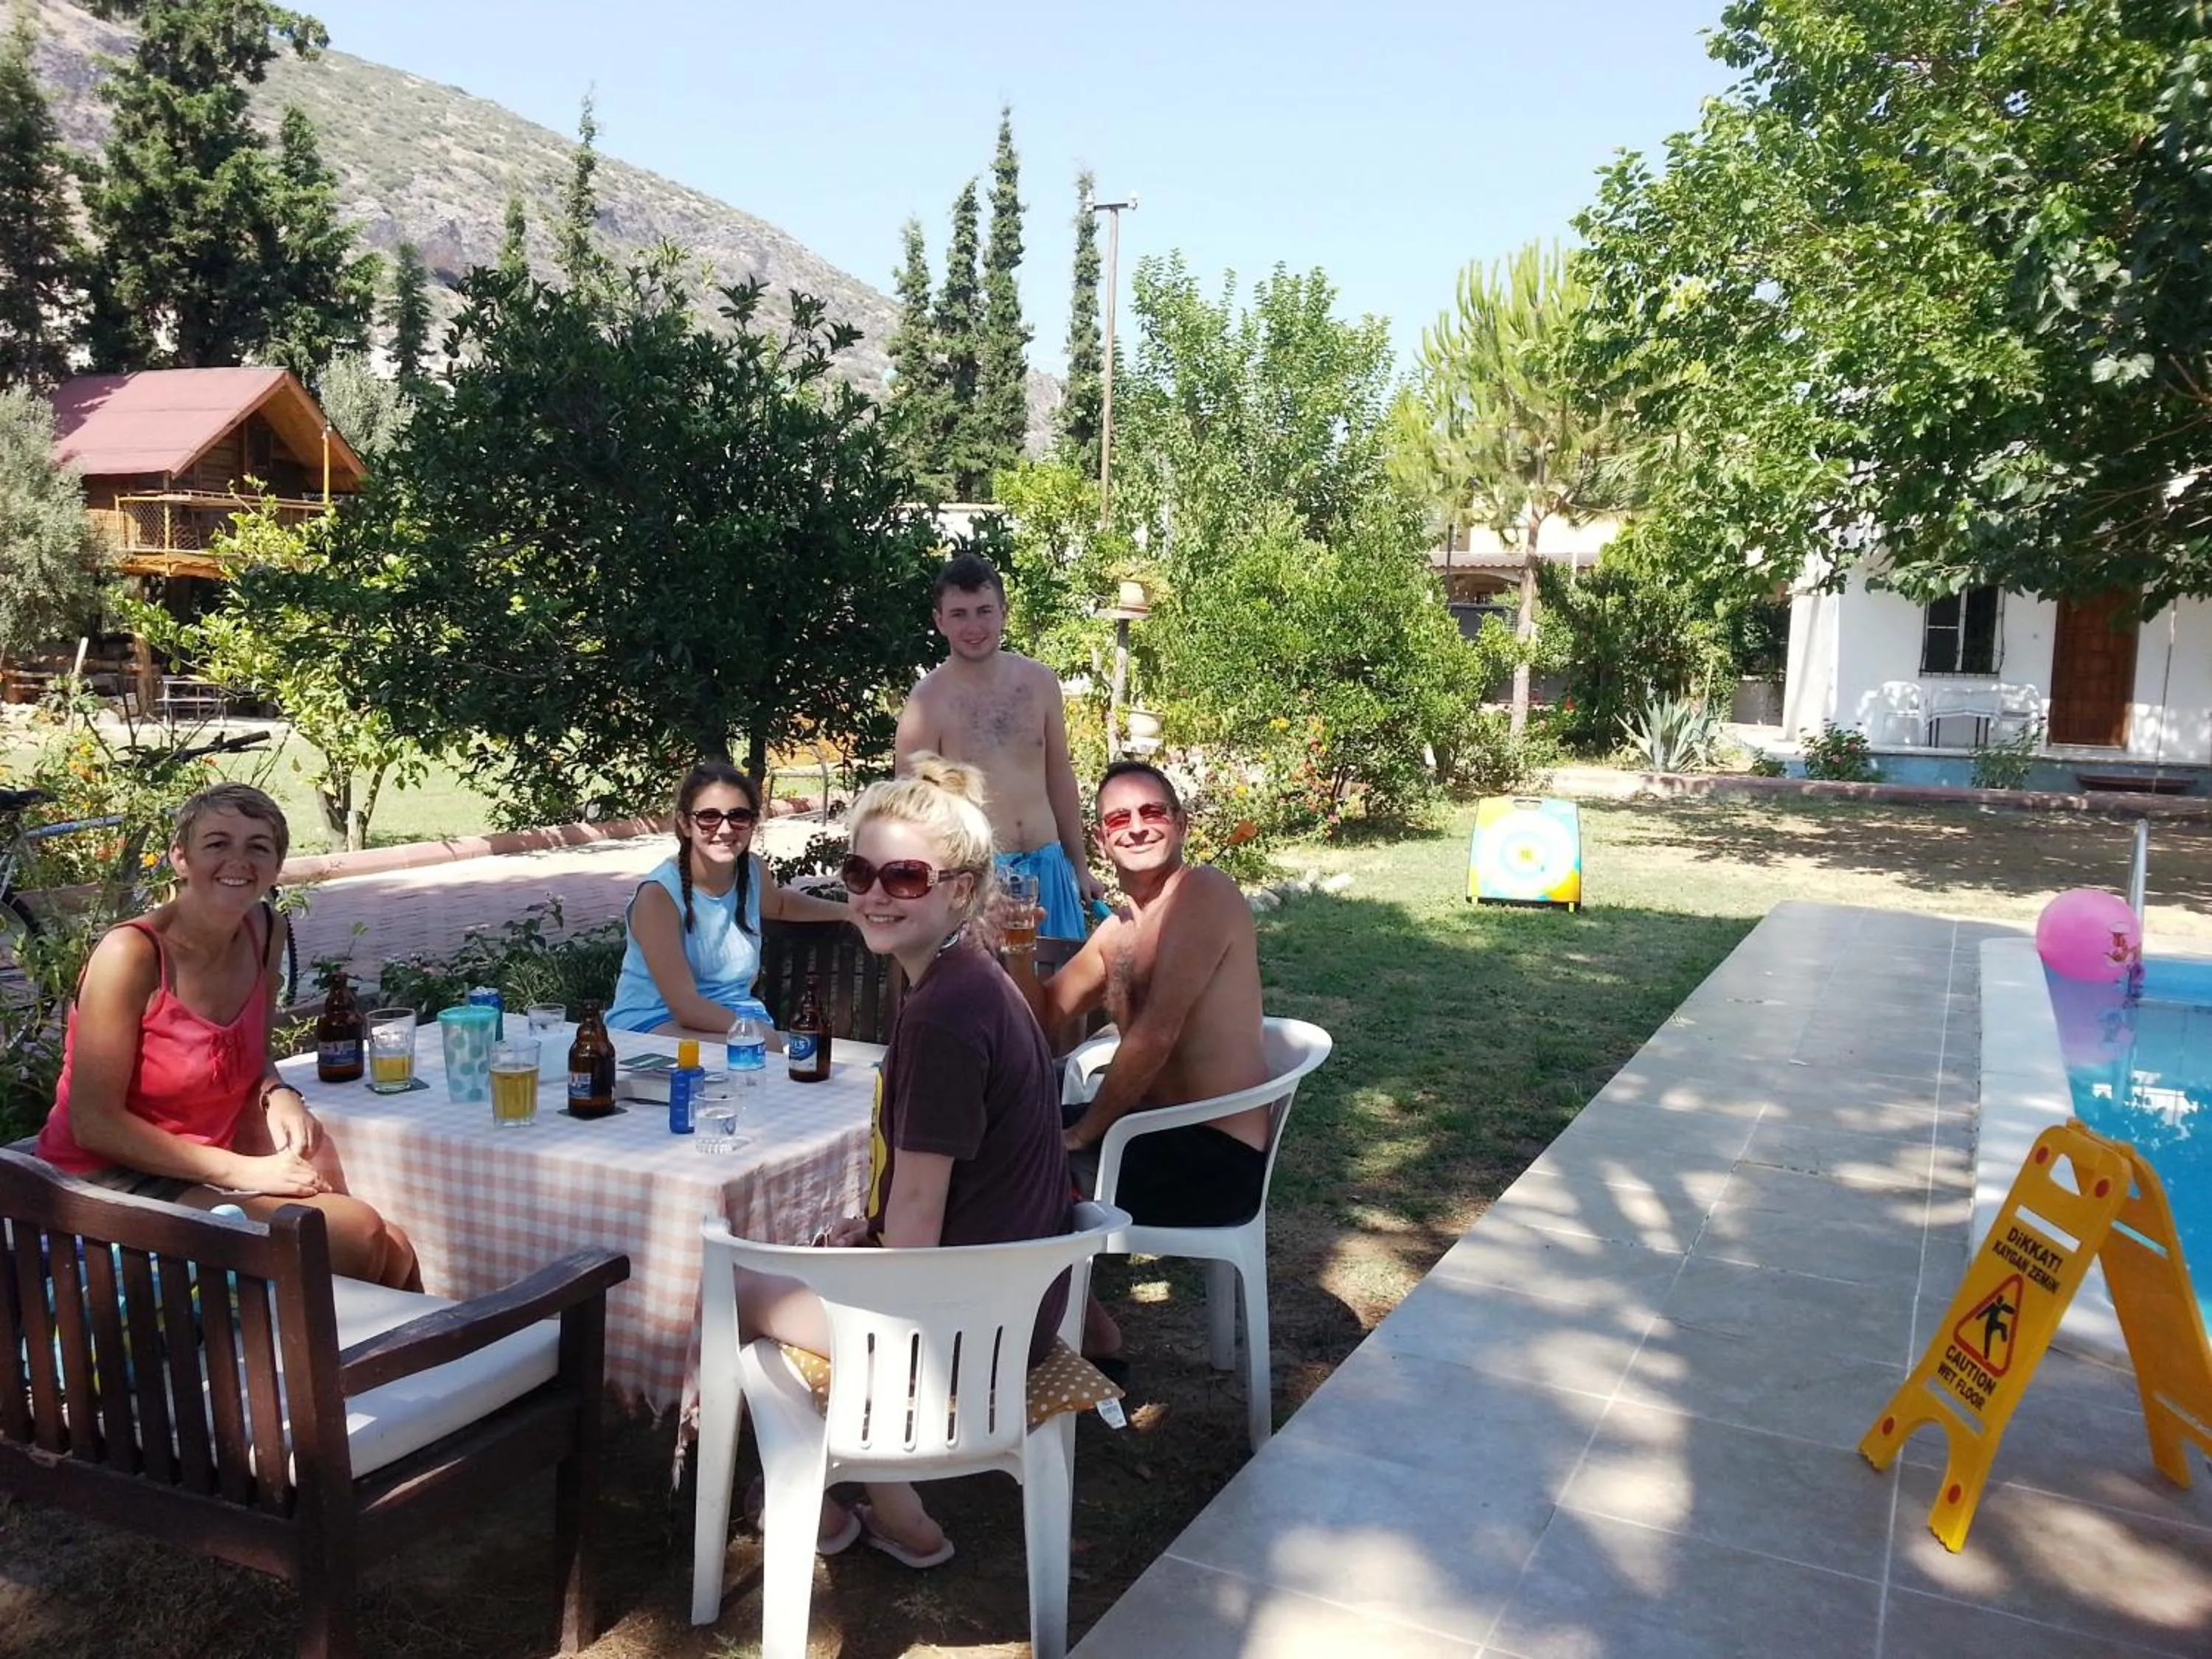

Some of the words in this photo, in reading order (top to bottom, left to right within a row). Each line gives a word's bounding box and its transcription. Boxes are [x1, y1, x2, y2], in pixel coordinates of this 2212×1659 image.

[1937, 1361, 1958, 1385] WET
[1955, 1378, 1986, 1412] FLOOR
[1946, 1344, 1997, 1397] CAUTION
